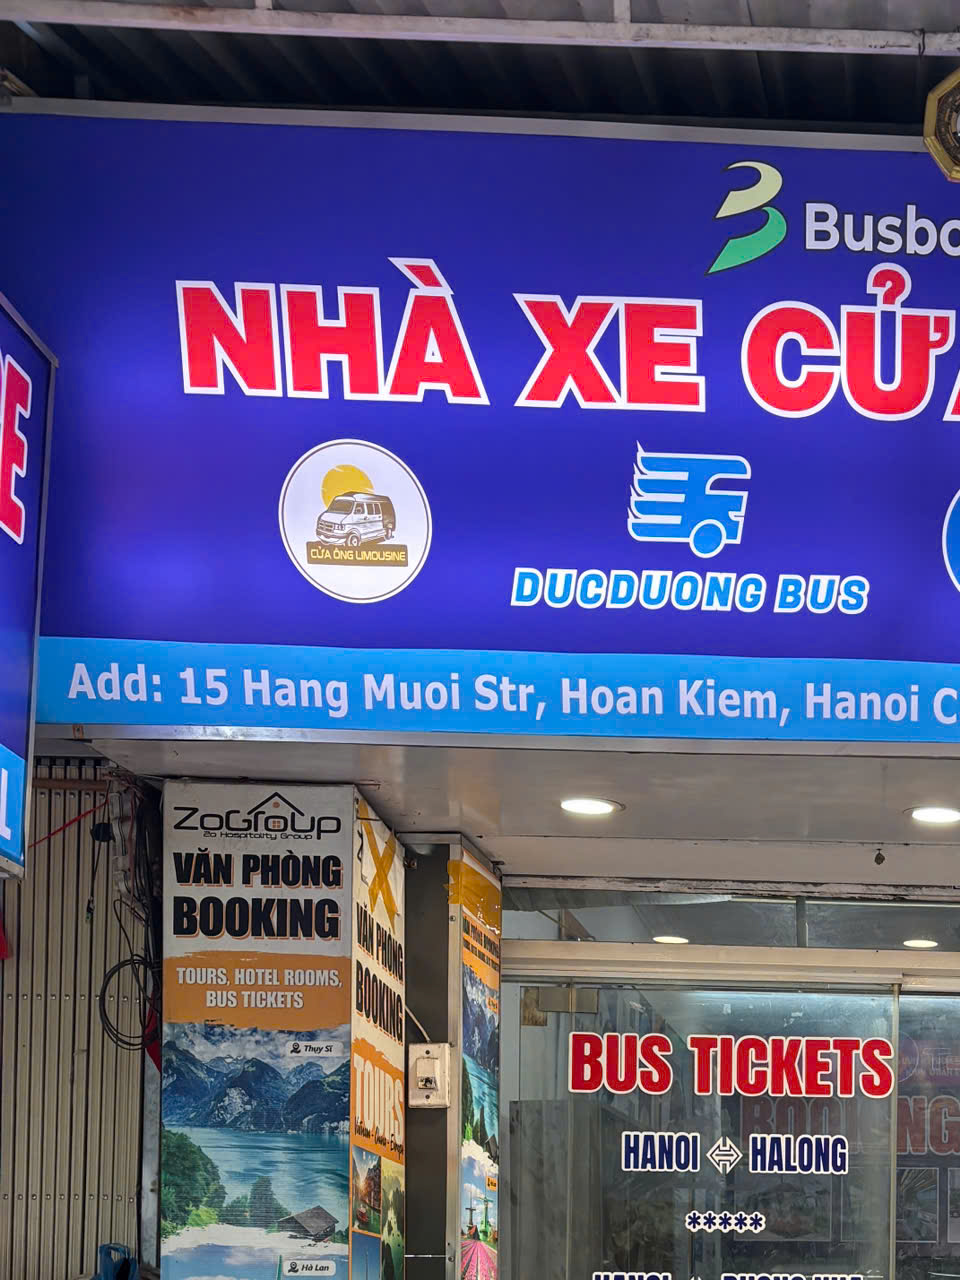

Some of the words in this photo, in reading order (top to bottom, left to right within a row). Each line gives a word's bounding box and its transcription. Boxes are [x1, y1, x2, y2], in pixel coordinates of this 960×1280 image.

[175, 257, 491, 406] NHÀ
[514, 292, 706, 413] XE
[311, 546, 332, 560] CỬA
[333, 547, 354, 560] ÔNG
[355, 550, 406, 562] LIMOUSINE
[511, 568, 766, 613] DUCDUONG
[773, 570, 870, 615] BUS
[68, 662, 163, 703] Add:
[180, 668, 228, 706] 15
[243, 669, 350, 719] Hang
[364, 672, 461, 711] Muoi
[474, 674, 546, 722] Str,
[562, 678, 664, 716] Hoan
[678, 679, 790, 727] Kiem,
[806, 682, 920, 722] Hanoi
[220, 831, 277, 841] Hospitality
[173, 848, 234, 888] VĂN
[241, 850, 344, 889] PHÒNG
[172, 895, 342, 941] BOOKING
[356, 901, 375, 960] VĂN
[176, 967, 231, 986] TOURS,
[233, 968, 280, 986] HOTEL
[283, 969, 343, 988] ROOMS,
[205, 991, 238, 1008] BUS
[241, 991, 304, 1009] TICKETS
[356, 959, 404, 1046] BOOKING
[303, 1044, 323, 1055] Thụy
[568, 1032, 673, 1094] BUS
[688, 1035, 894, 1098] TICKETS
[353, 1052, 404, 1146] TOURS
[621, 1131, 700, 1172] HANOI
[749, 1134, 849, 1174] HALONG
[301, 1262, 313, 1271] Hà
[315, 1263, 330, 1272] Lan
